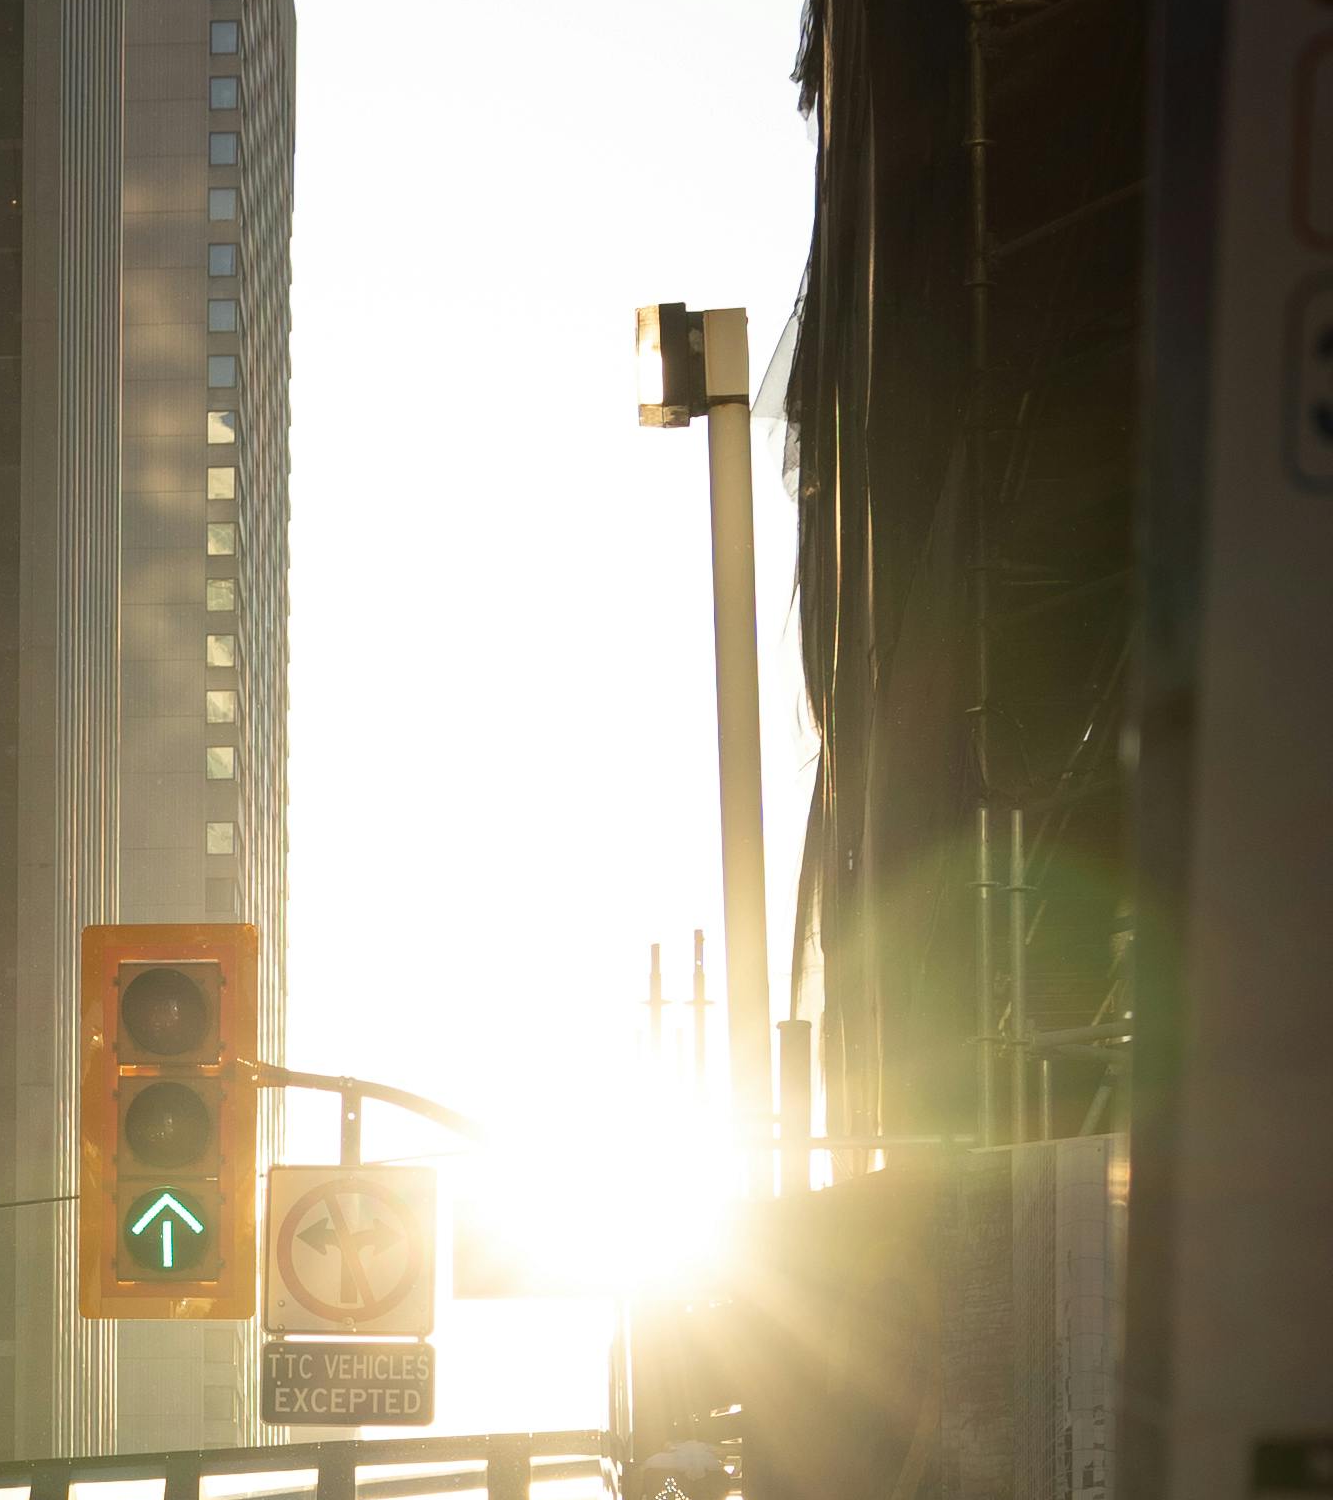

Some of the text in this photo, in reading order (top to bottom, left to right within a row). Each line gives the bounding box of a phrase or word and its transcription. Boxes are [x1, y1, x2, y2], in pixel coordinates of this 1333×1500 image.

[268, 1354, 430, 1381] TTC VEHICLES
[274, 1387, 422, 1414] EXCEPTED
